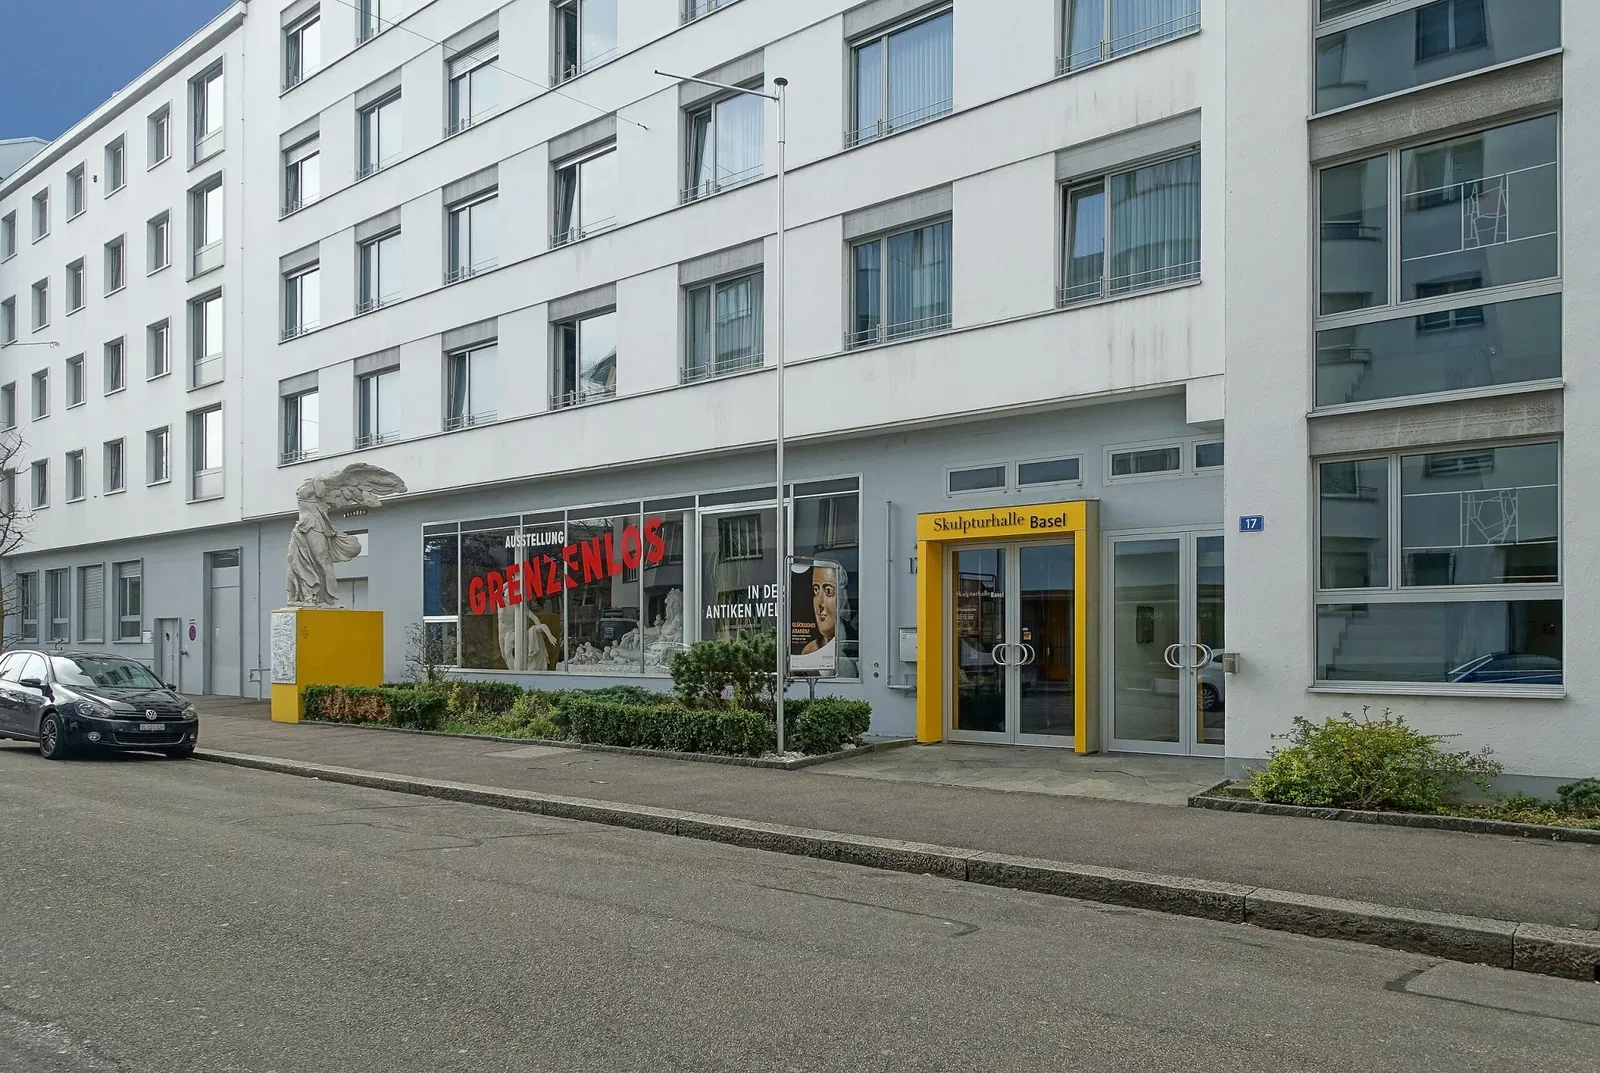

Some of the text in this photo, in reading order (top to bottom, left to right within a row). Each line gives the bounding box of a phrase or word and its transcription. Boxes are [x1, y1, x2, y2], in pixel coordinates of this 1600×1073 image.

[933, 511, 1067, 534] Skulpturhalle Basel
[1245, 518, 1257, 529] 17
[505, 530, 565, 549] AUSSTELLUNG
[468, 516, 666, 616] GRENZENLOS
[748, 583, 785, 600] IN DE
[706, 602, 785, 619] ANTIKEN WEL
